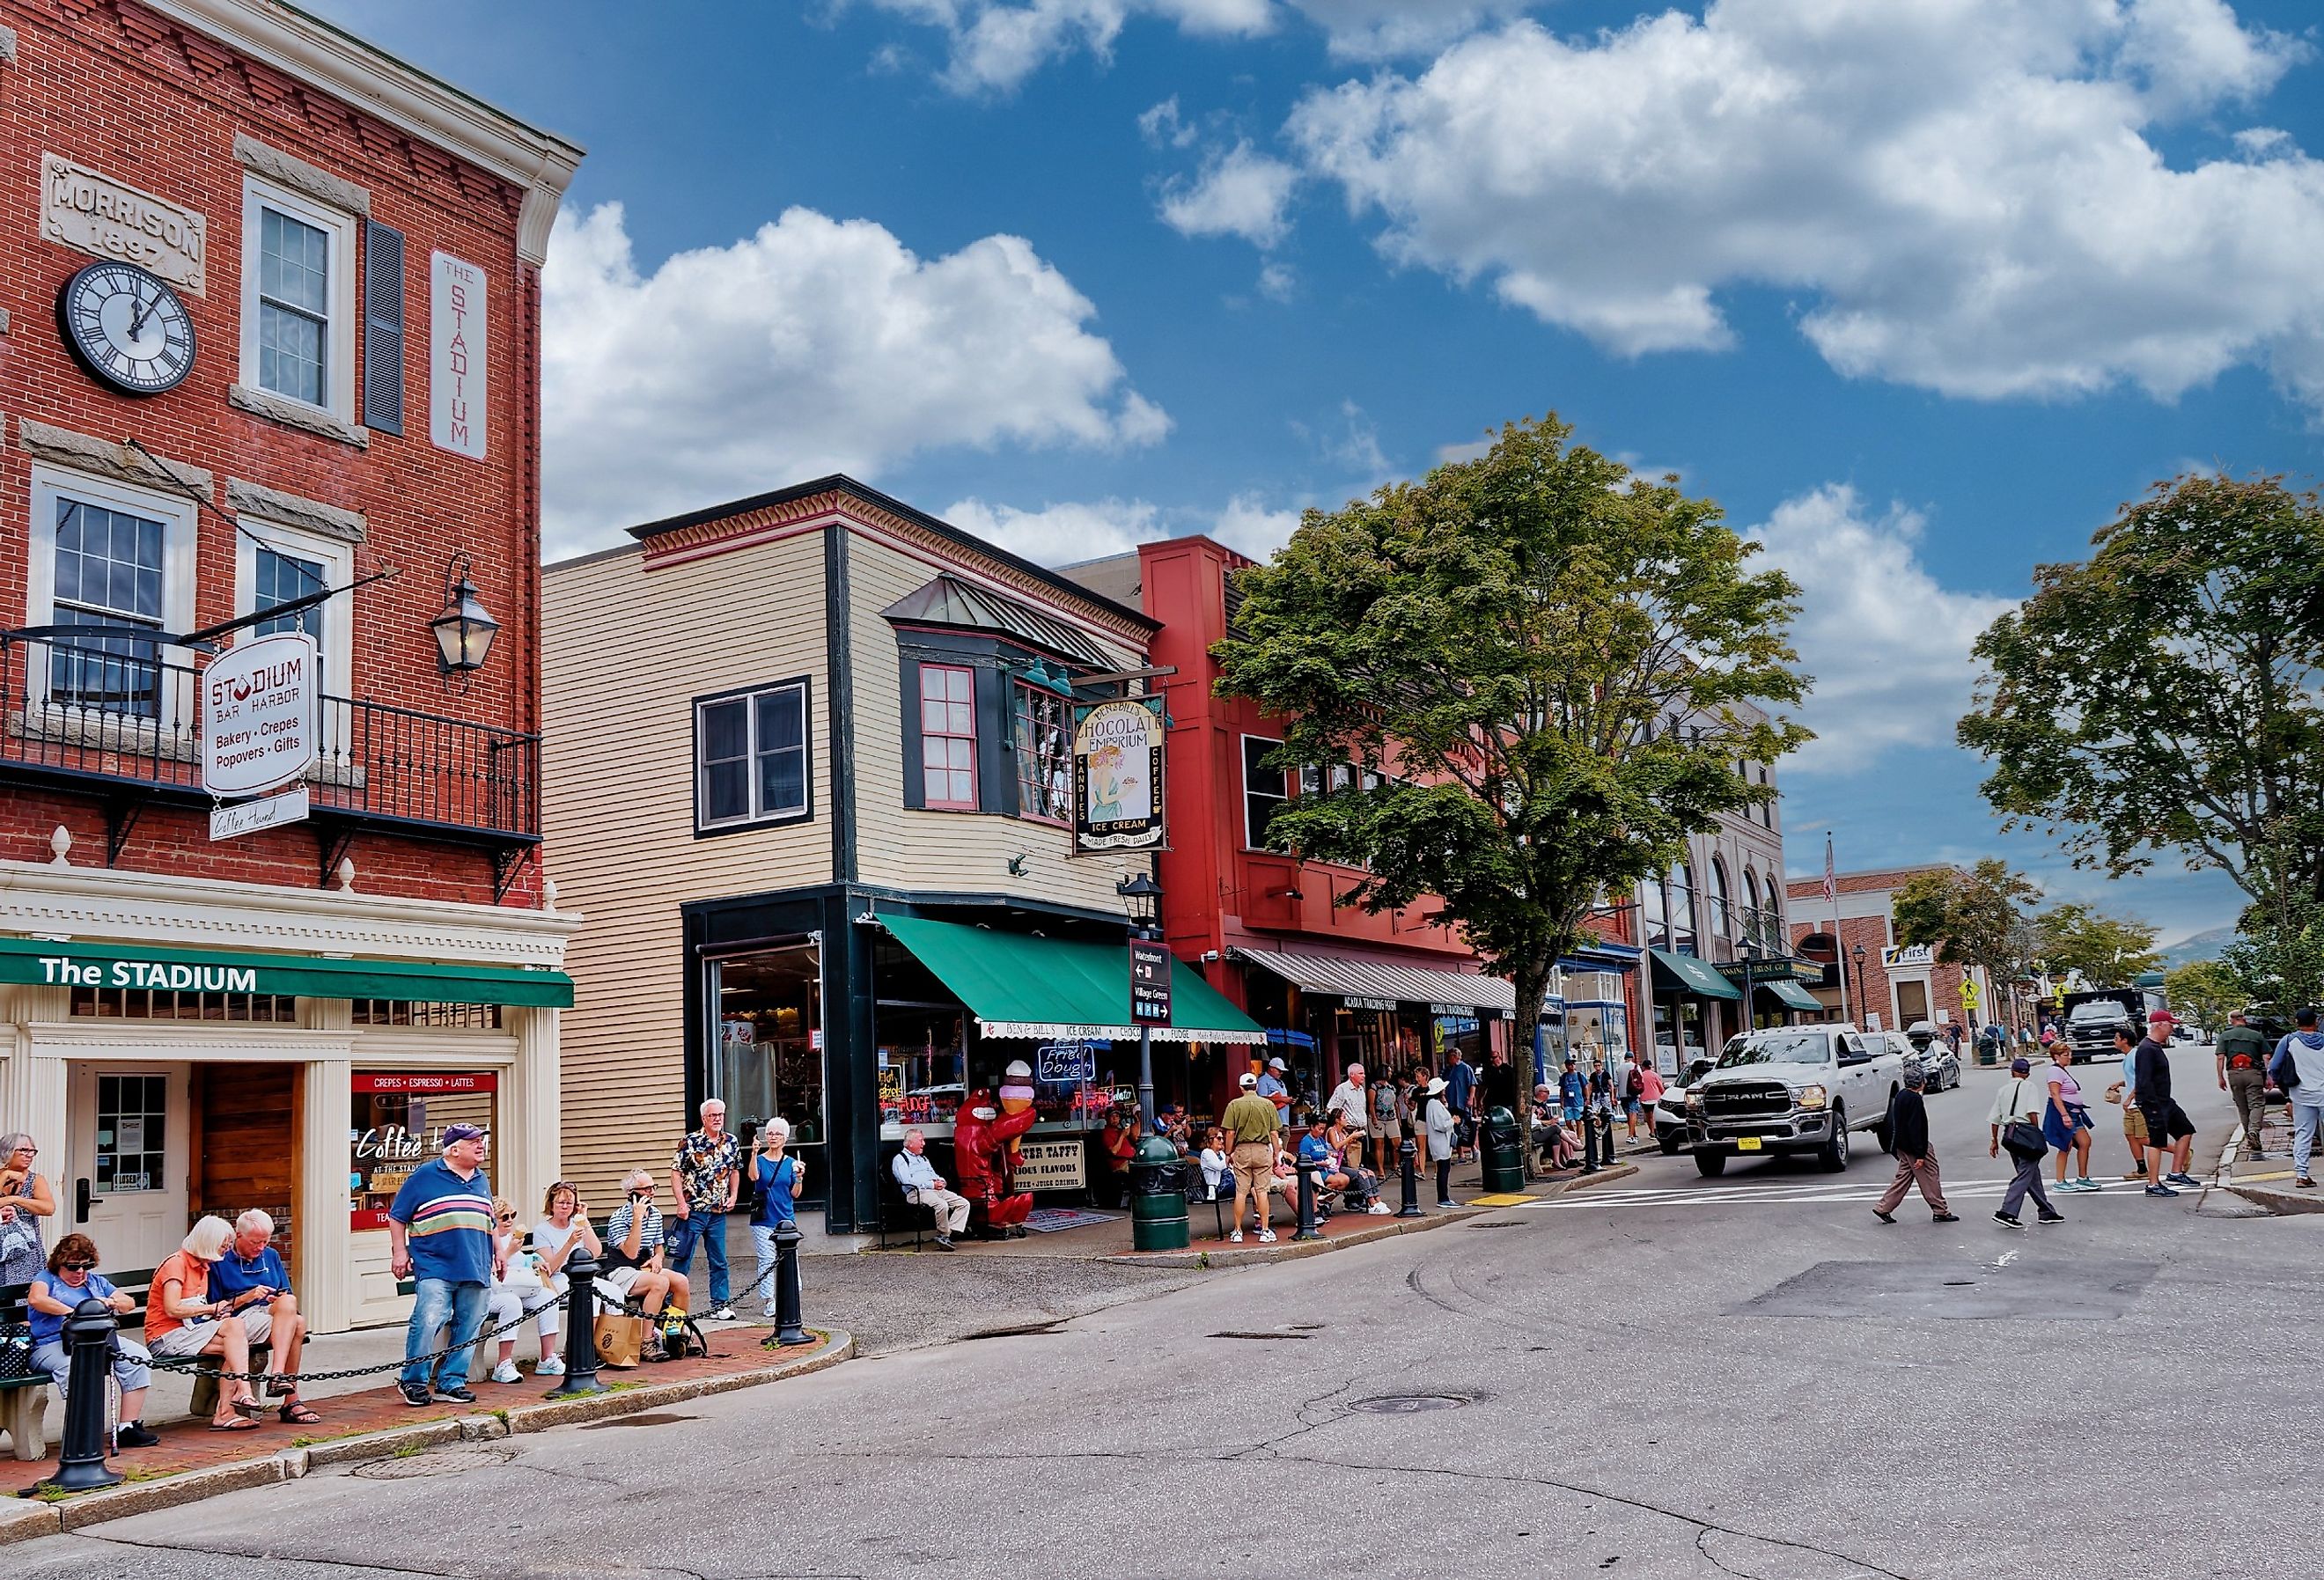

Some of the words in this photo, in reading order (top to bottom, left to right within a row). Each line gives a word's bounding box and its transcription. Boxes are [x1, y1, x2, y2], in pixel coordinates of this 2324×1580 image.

[53, 176, 201, 262] MORRISON
[90, 225, 164, 267] 1897
[443, 260, 474, 285] THE
[85, 284, 105, 302] X
[166, 335, 186, 348] III
[150, 360, 160, 379] V
[450, 283, 468, 447] STADIUM
[216, 704, 240, 724] BAR
[252, 687, 300, 714] HARBOR
[1094, 704, 1114, 721] BEN
[1119, 702, 1141, 717] BILL'S
[216, 729, 252, 750] Bakery
[261, 717, 299, 738] Crepes
[1076, 715, 1161, 739] CHOCOLATE
[1089, 733, 1148, 752] EMPORIUM
[216, 746, 265, 770] Popovers
[274, 736, 300, 753] Gifts
[1151, 747, 1160, 805] COFFEE
[214, 812, 245, 835] Coffee
[1092, 821, 1107, 833] ICE
[1112, 819, 1146, 831] CREAM
[1109, 834, 1131, 845] FRESH
[1133, 833, 1153, 845] DAILY
[1135, 950, 1163, 965] Waterfront
[1902, 946, 1928, 958] First
[40, 958, 103, 988] The
[111, 961, 258, 994] STADIUM
[1135, 987, 1153, 1001] Village
[1152, 989, 1169, 1001] Green
[1344, 996, 1362, 1009] ACADIA
[1363, 998, 1385, 1010] TRADING
[1385, 999, 1396, 1011] POST
[1430, 1003, 1446, 1015] ACADIA
[1464, 1006, 1475, 1017] POST
[1006, 1024, 1023, 1034] BEN
[1033, 1025, 1055, 1035] BILL'S
[1066, 1025, 1077, 1036] ICE
[1078, 1026, 1102, 1037] CREAM
[1120, 1027, 1154, 1038] CHOCOE
[1171, 1029, 1189, 1039] FUDGE
[1047, 1047, 1087, 1061] Fried
[1041, 1062, 1092, 1077] Dough
[374, 1077, 402, 1088] CREPES
[408, 1077, 444, 1088] ESPRESSO
[451, 1077, 474, 1088] LATTES
[879, 1084, 903, 1098] etzels
[355, 1126, 423, 1158] Coffee
[1019, 1146, 1043, 1159] TER
[1046, 1145, 1078, 1158] TAFFY
[373, 1165, 383, 1174] AT
[385, 1165, 397, 1173] THE
[1041, 1163, 1077, 1174] FLAVORS
